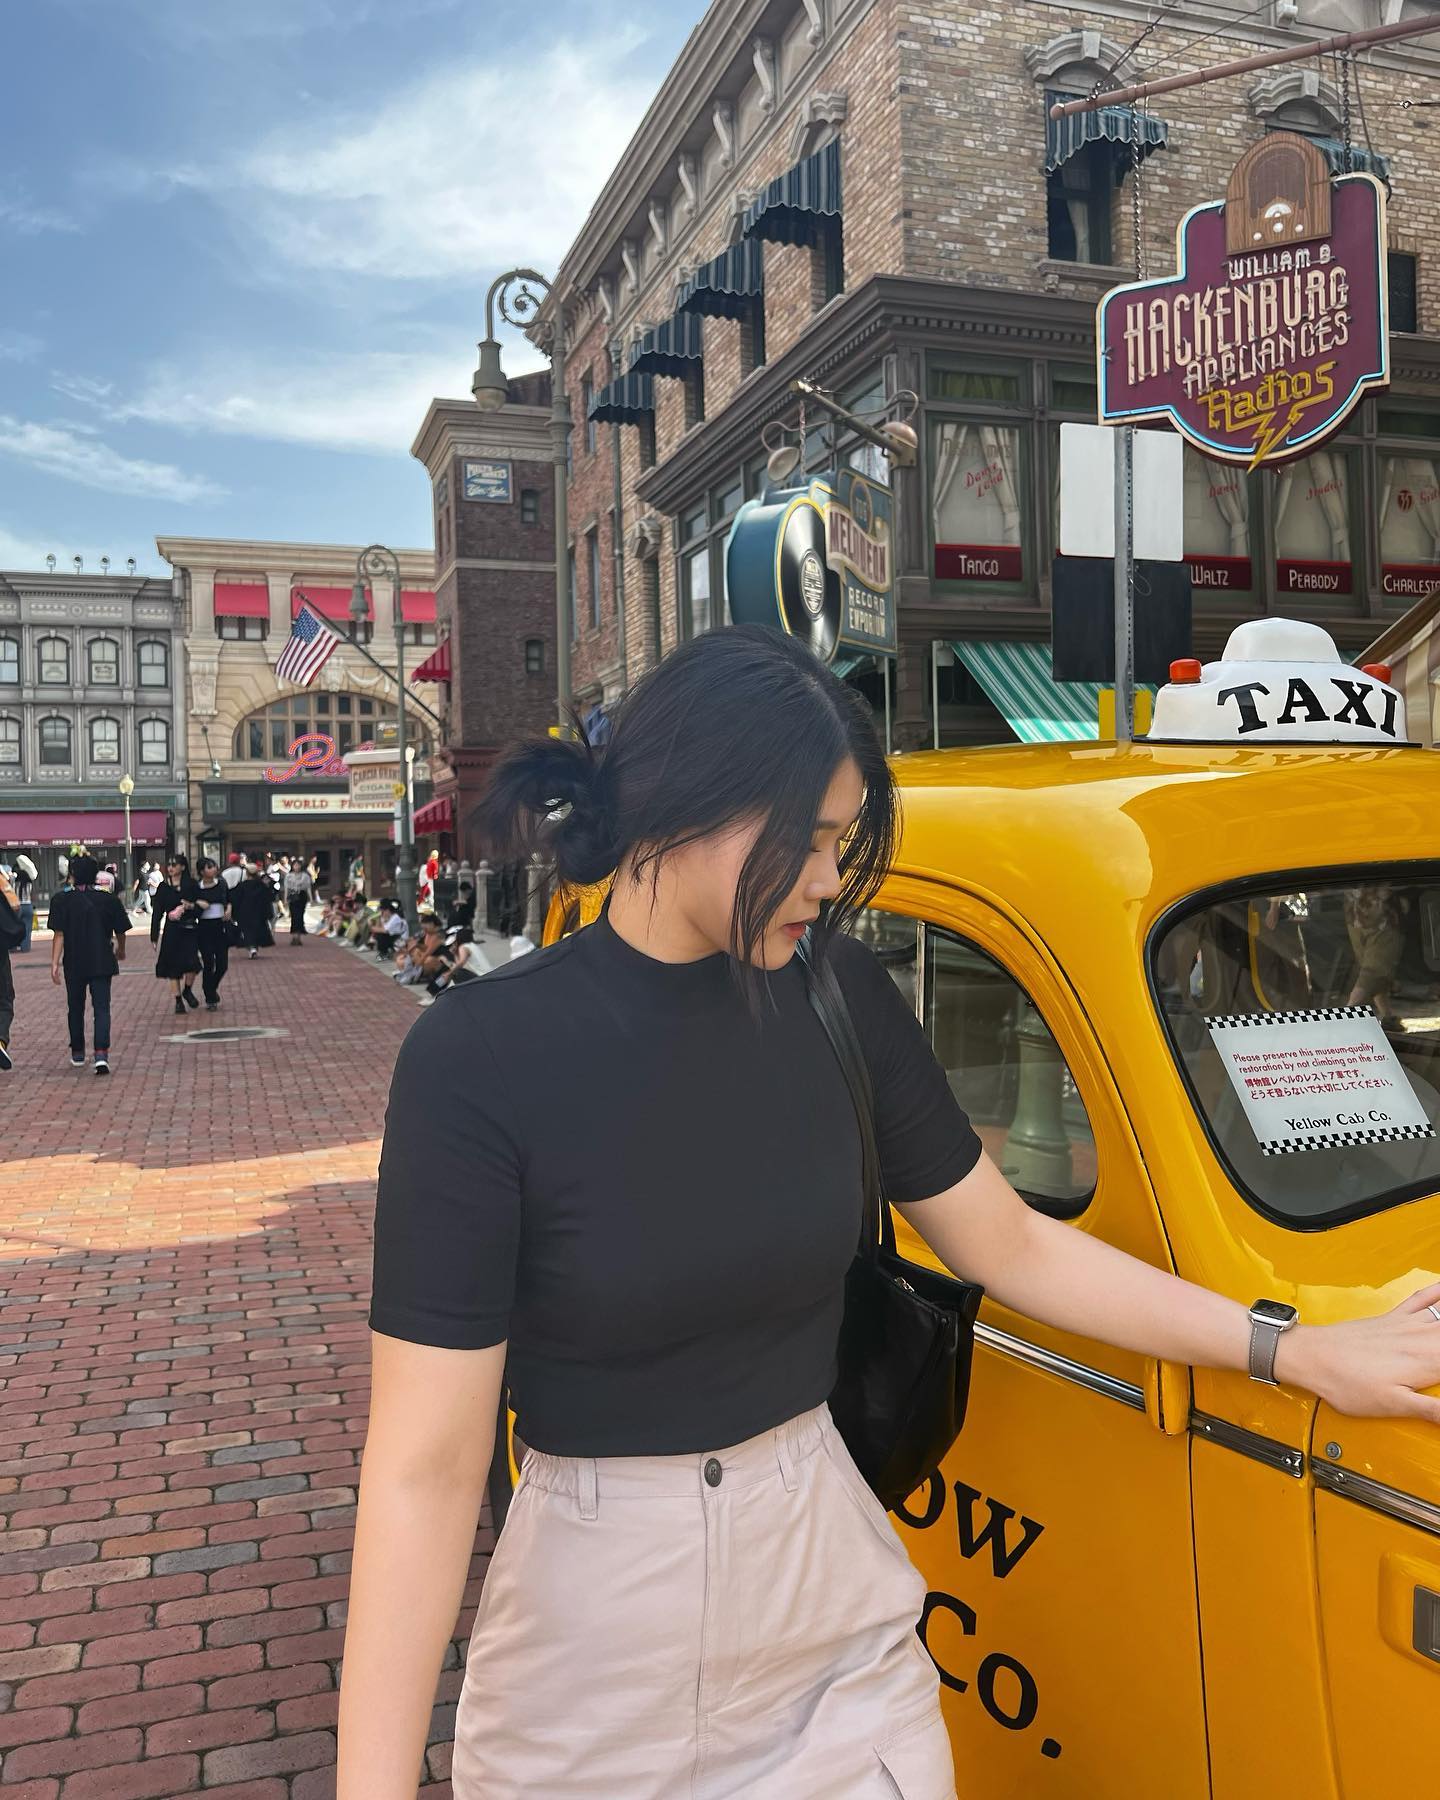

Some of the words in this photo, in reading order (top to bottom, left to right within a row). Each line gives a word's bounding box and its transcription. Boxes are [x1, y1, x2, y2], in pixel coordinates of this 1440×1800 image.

[1228, 247, 1311, 281] WILLIAM
[1319, 243, 1334, 265] B
[1123, 266, 1350, 386] HACKENBURG
[1183, 309, 1351, 400] APPLIANCES
[1197, 361, 1338, 434] Radios
[958, 554, 999, 576] TANGO
[1190, 564, 1229, 586] WALTZ
[1289, 568, 1339, 590] PEABODY
[848, 586, 885, 617] RECORD
[1216, 677, 1398, 738] TAXI
[282, 799, 329, 809] WORLD
[1232, 1053, 1261, 1063] Please
[1262, 1051, 1298, 1063] preserve
[1299, 1047, 1314, 1057] this
[1315, 1042, 1375, 1056] museum-quality
[1239, 1062, 1283, 1074] restoration
[1283, 1060, 1295, 1072] by
[1297, 1059, 1310, 1068] not
[1312, 1056, 1347, 1067] climbing
[1347, 1056, 1359, 1064] on
[1359, 1054, 1372, 1063] the
[1284, 1116, 1332, 1131] Yellow
[1336, 1112, 1365, 1126] Cab
[1368, 1109, 1392, 1122] Co.
